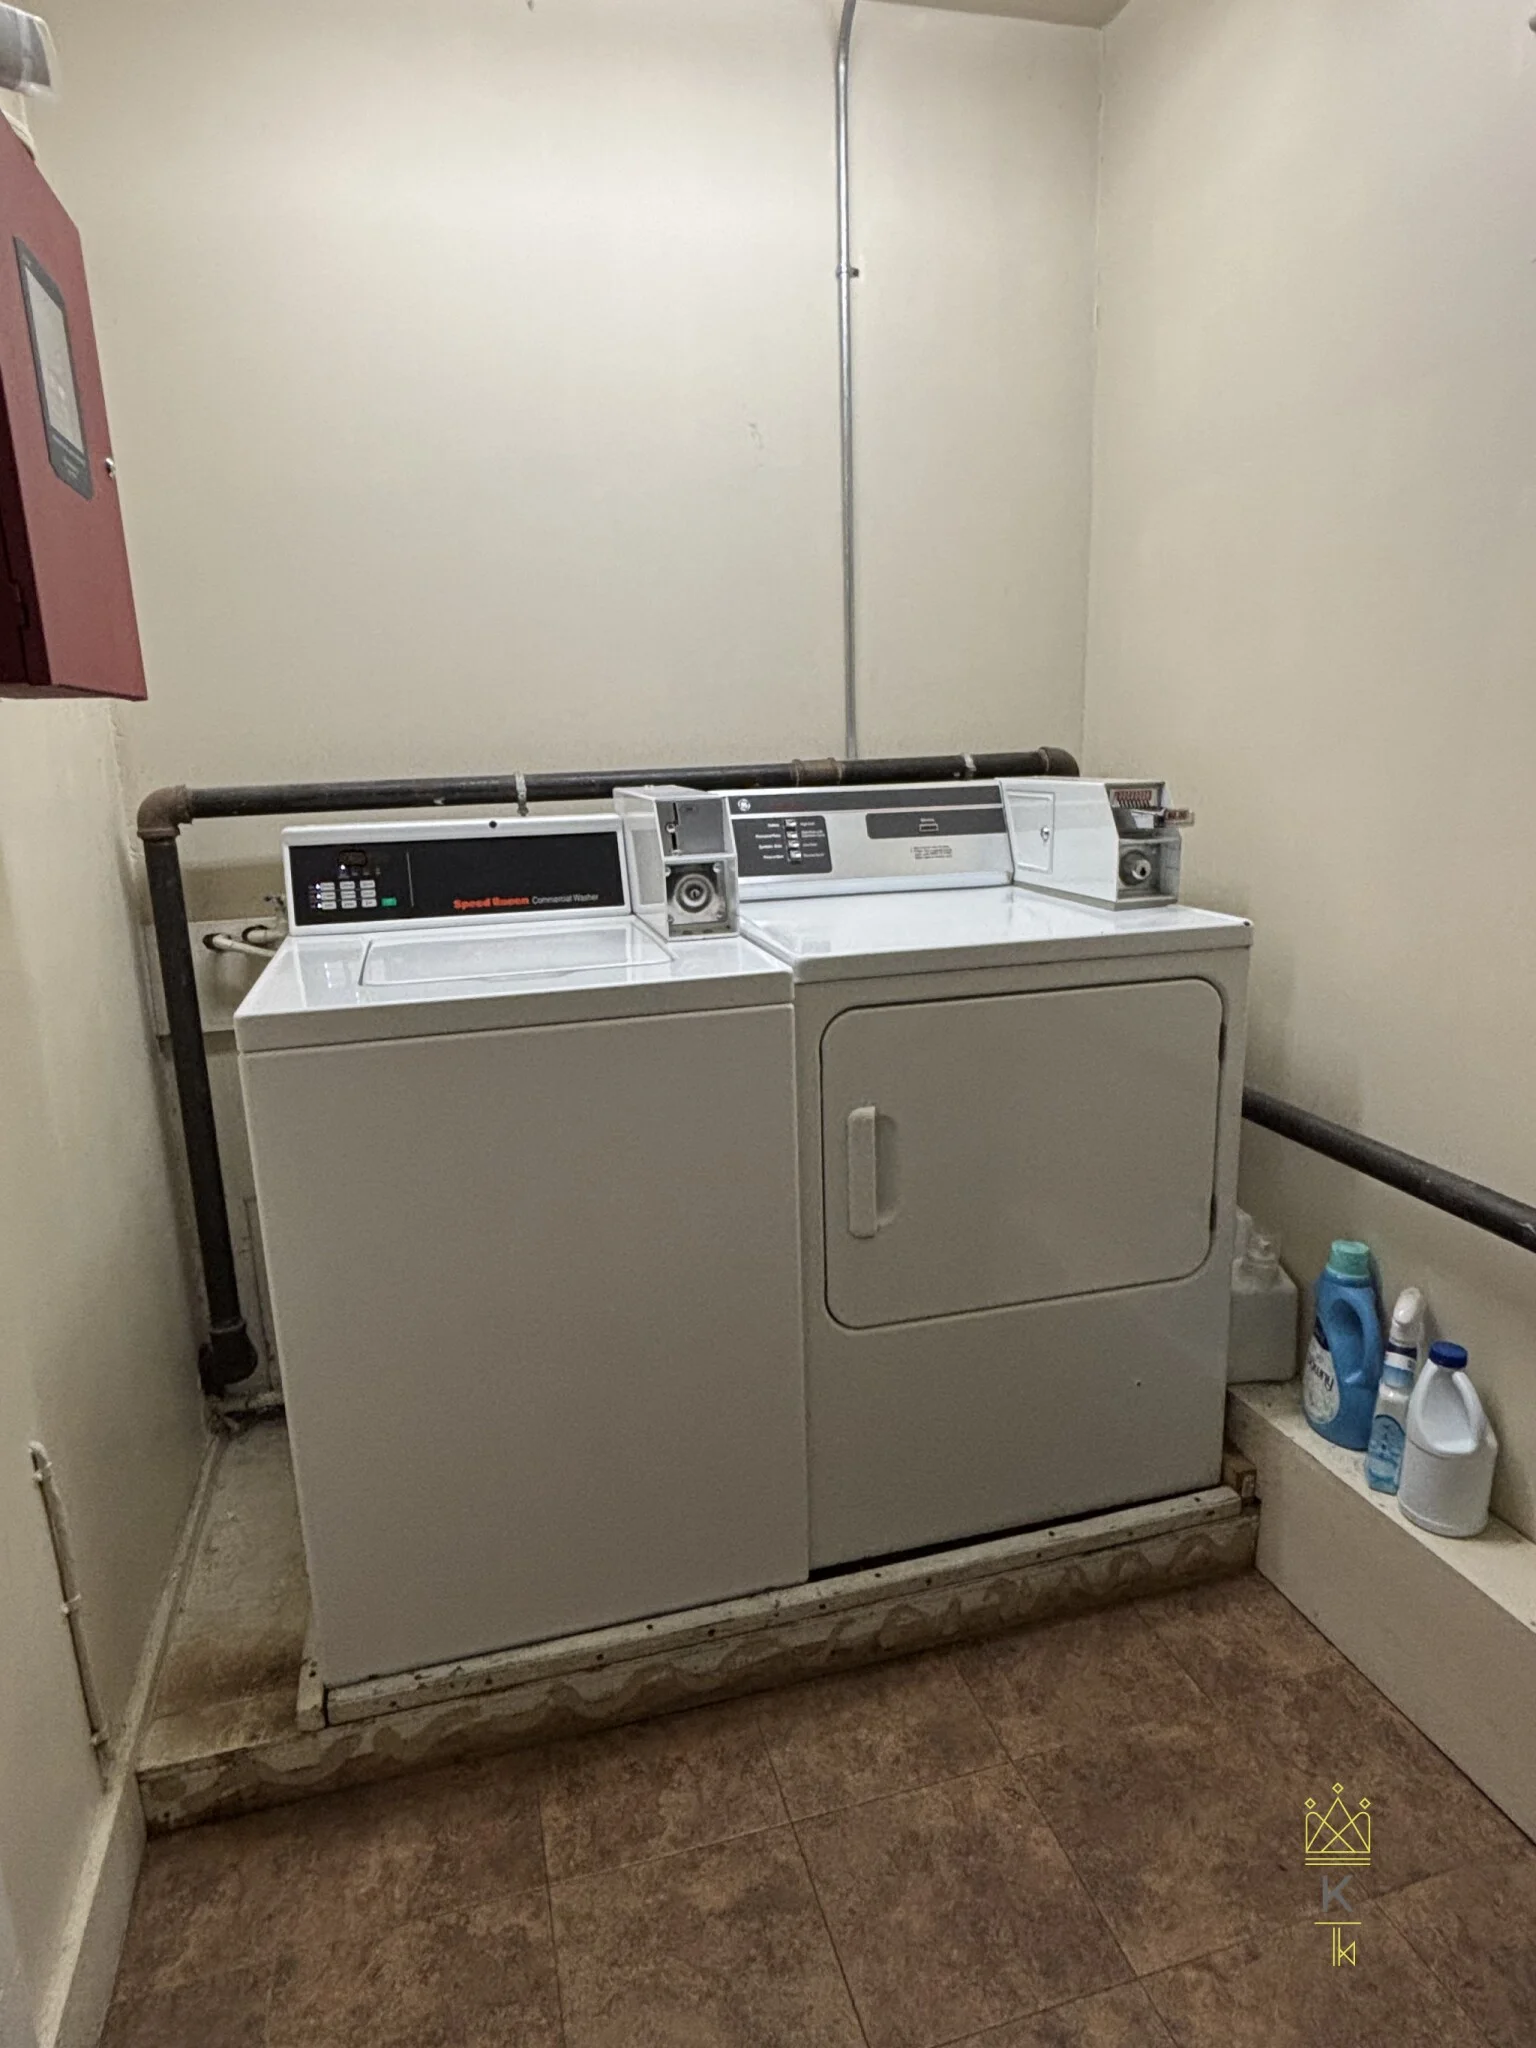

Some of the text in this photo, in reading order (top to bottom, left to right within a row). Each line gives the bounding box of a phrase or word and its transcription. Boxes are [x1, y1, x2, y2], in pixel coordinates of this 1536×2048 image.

[453, 894, 599, 909] Speed Queen Commercial Washer
